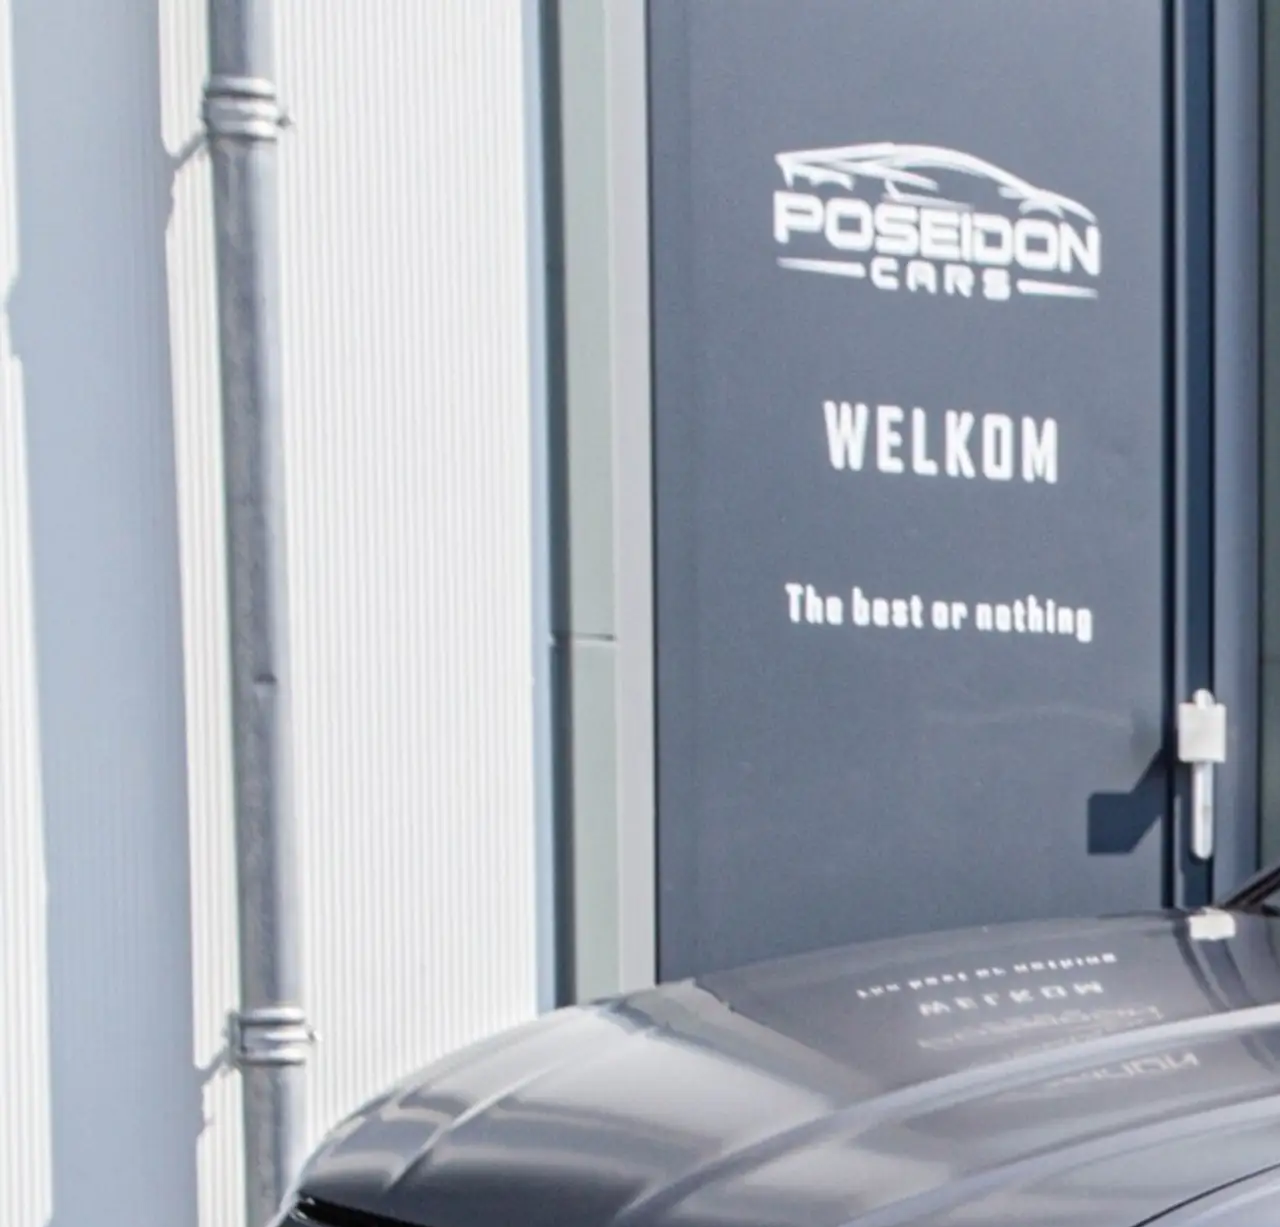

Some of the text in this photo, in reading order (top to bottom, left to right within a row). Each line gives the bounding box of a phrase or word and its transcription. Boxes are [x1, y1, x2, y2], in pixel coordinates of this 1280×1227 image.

[773, 190, 1101, 276] POSEIDON
[870, 255, 1012, 302] CARS
[823, 400, 1058, 484] WELKOM
[784, 582, 1093, 643] The best or nothing
